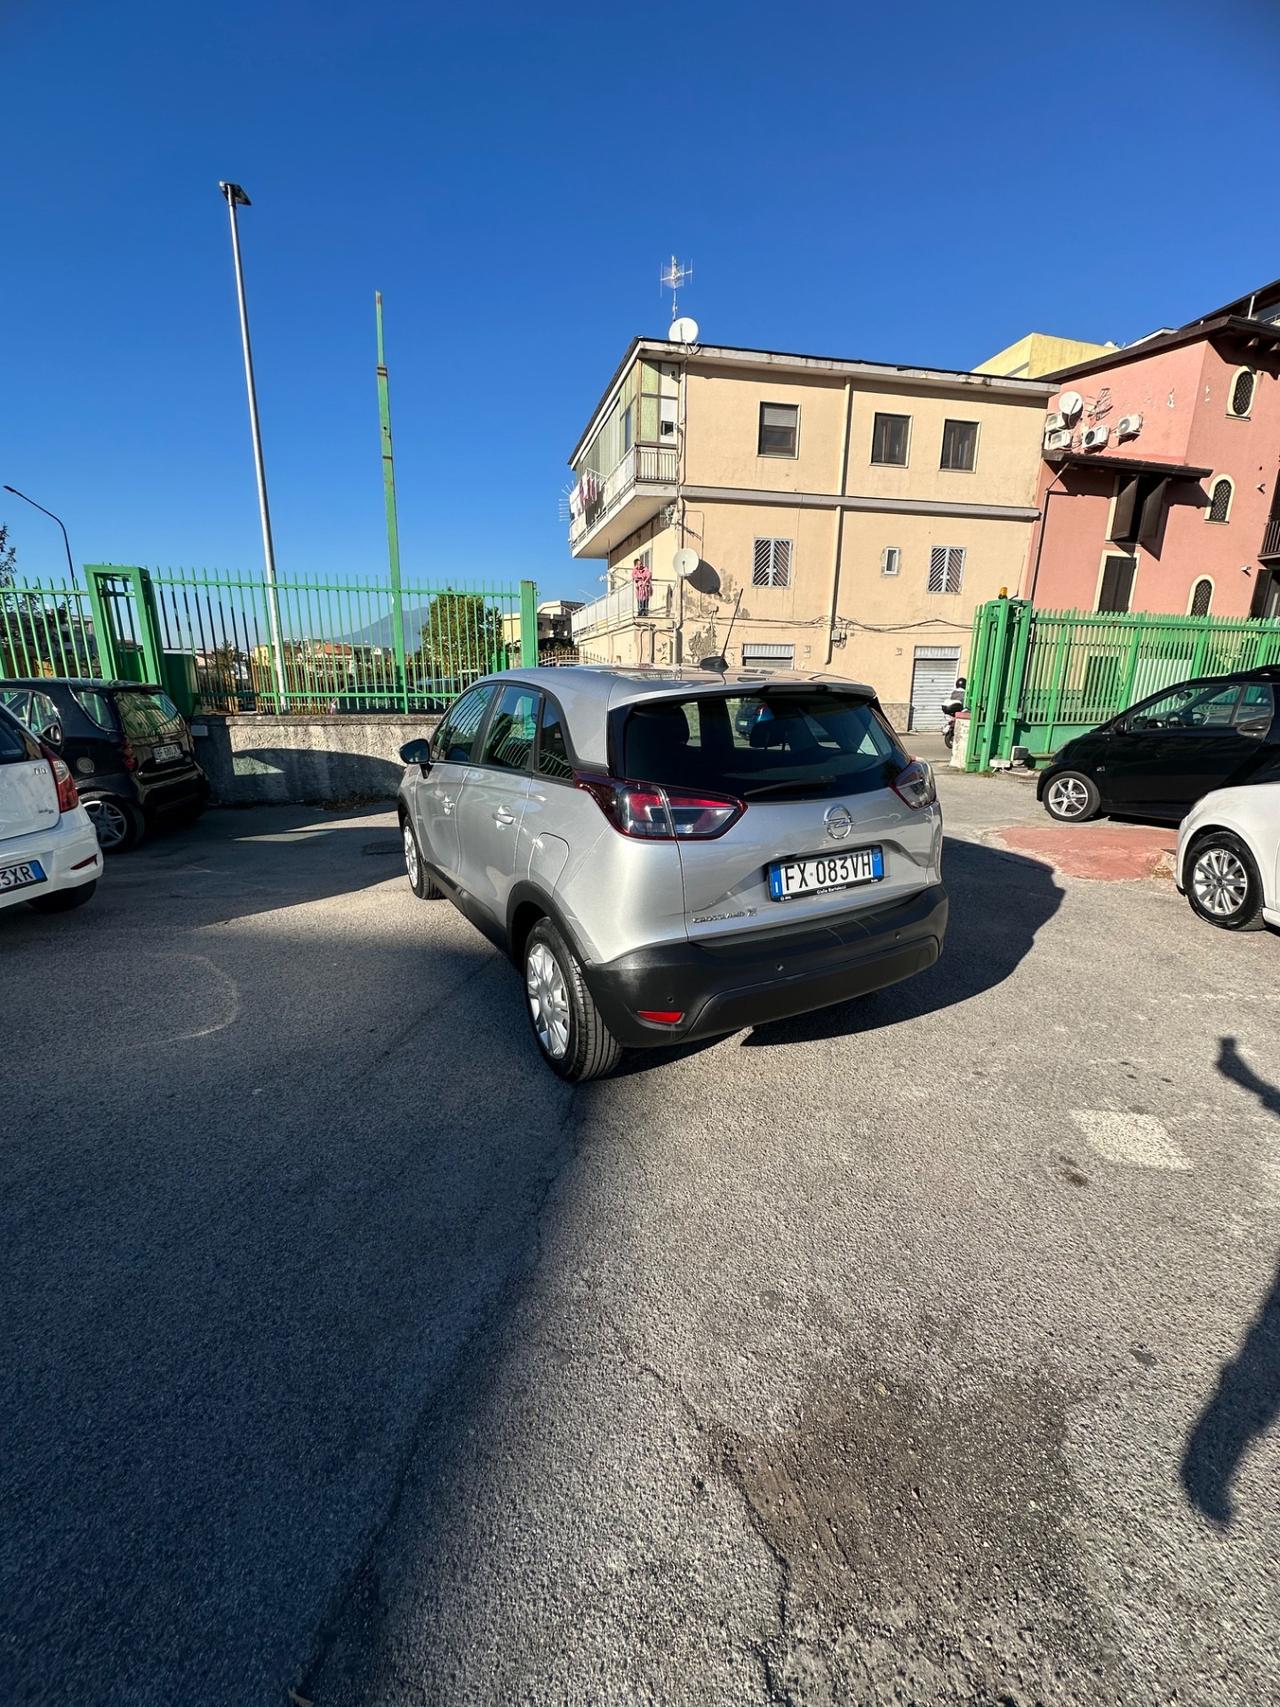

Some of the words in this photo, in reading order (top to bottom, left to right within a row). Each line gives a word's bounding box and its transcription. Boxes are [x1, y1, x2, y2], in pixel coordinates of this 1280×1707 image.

[0, 866, 34, 887] 3XR
[783, 862, 809, 891] FX
[815, 852, 872, 885] 083VH
